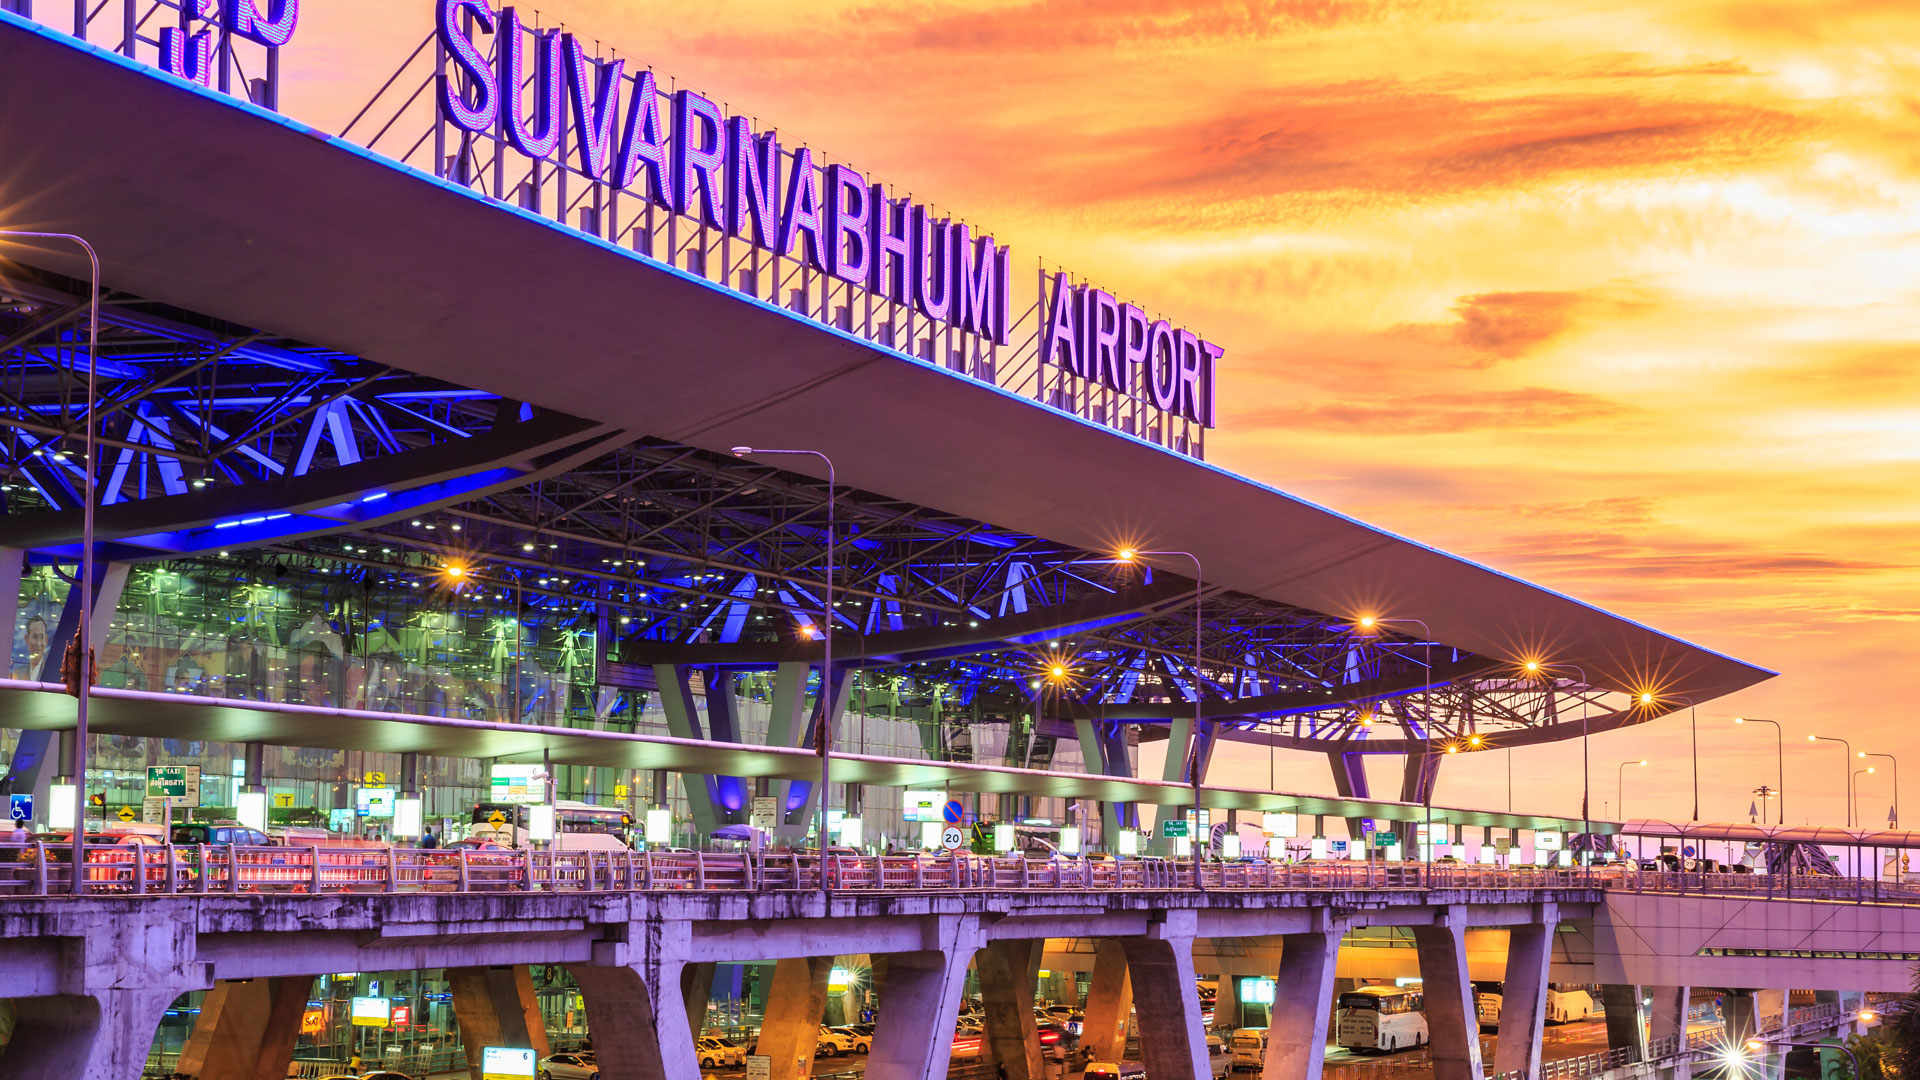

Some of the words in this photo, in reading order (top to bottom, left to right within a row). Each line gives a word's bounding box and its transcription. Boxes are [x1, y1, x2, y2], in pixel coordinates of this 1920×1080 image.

[436, 0, 1010, 346] SUVARNABHUMI
[1041, 272, 1224, 429] AIRPORT
[945, 833, 960, 843] 20
